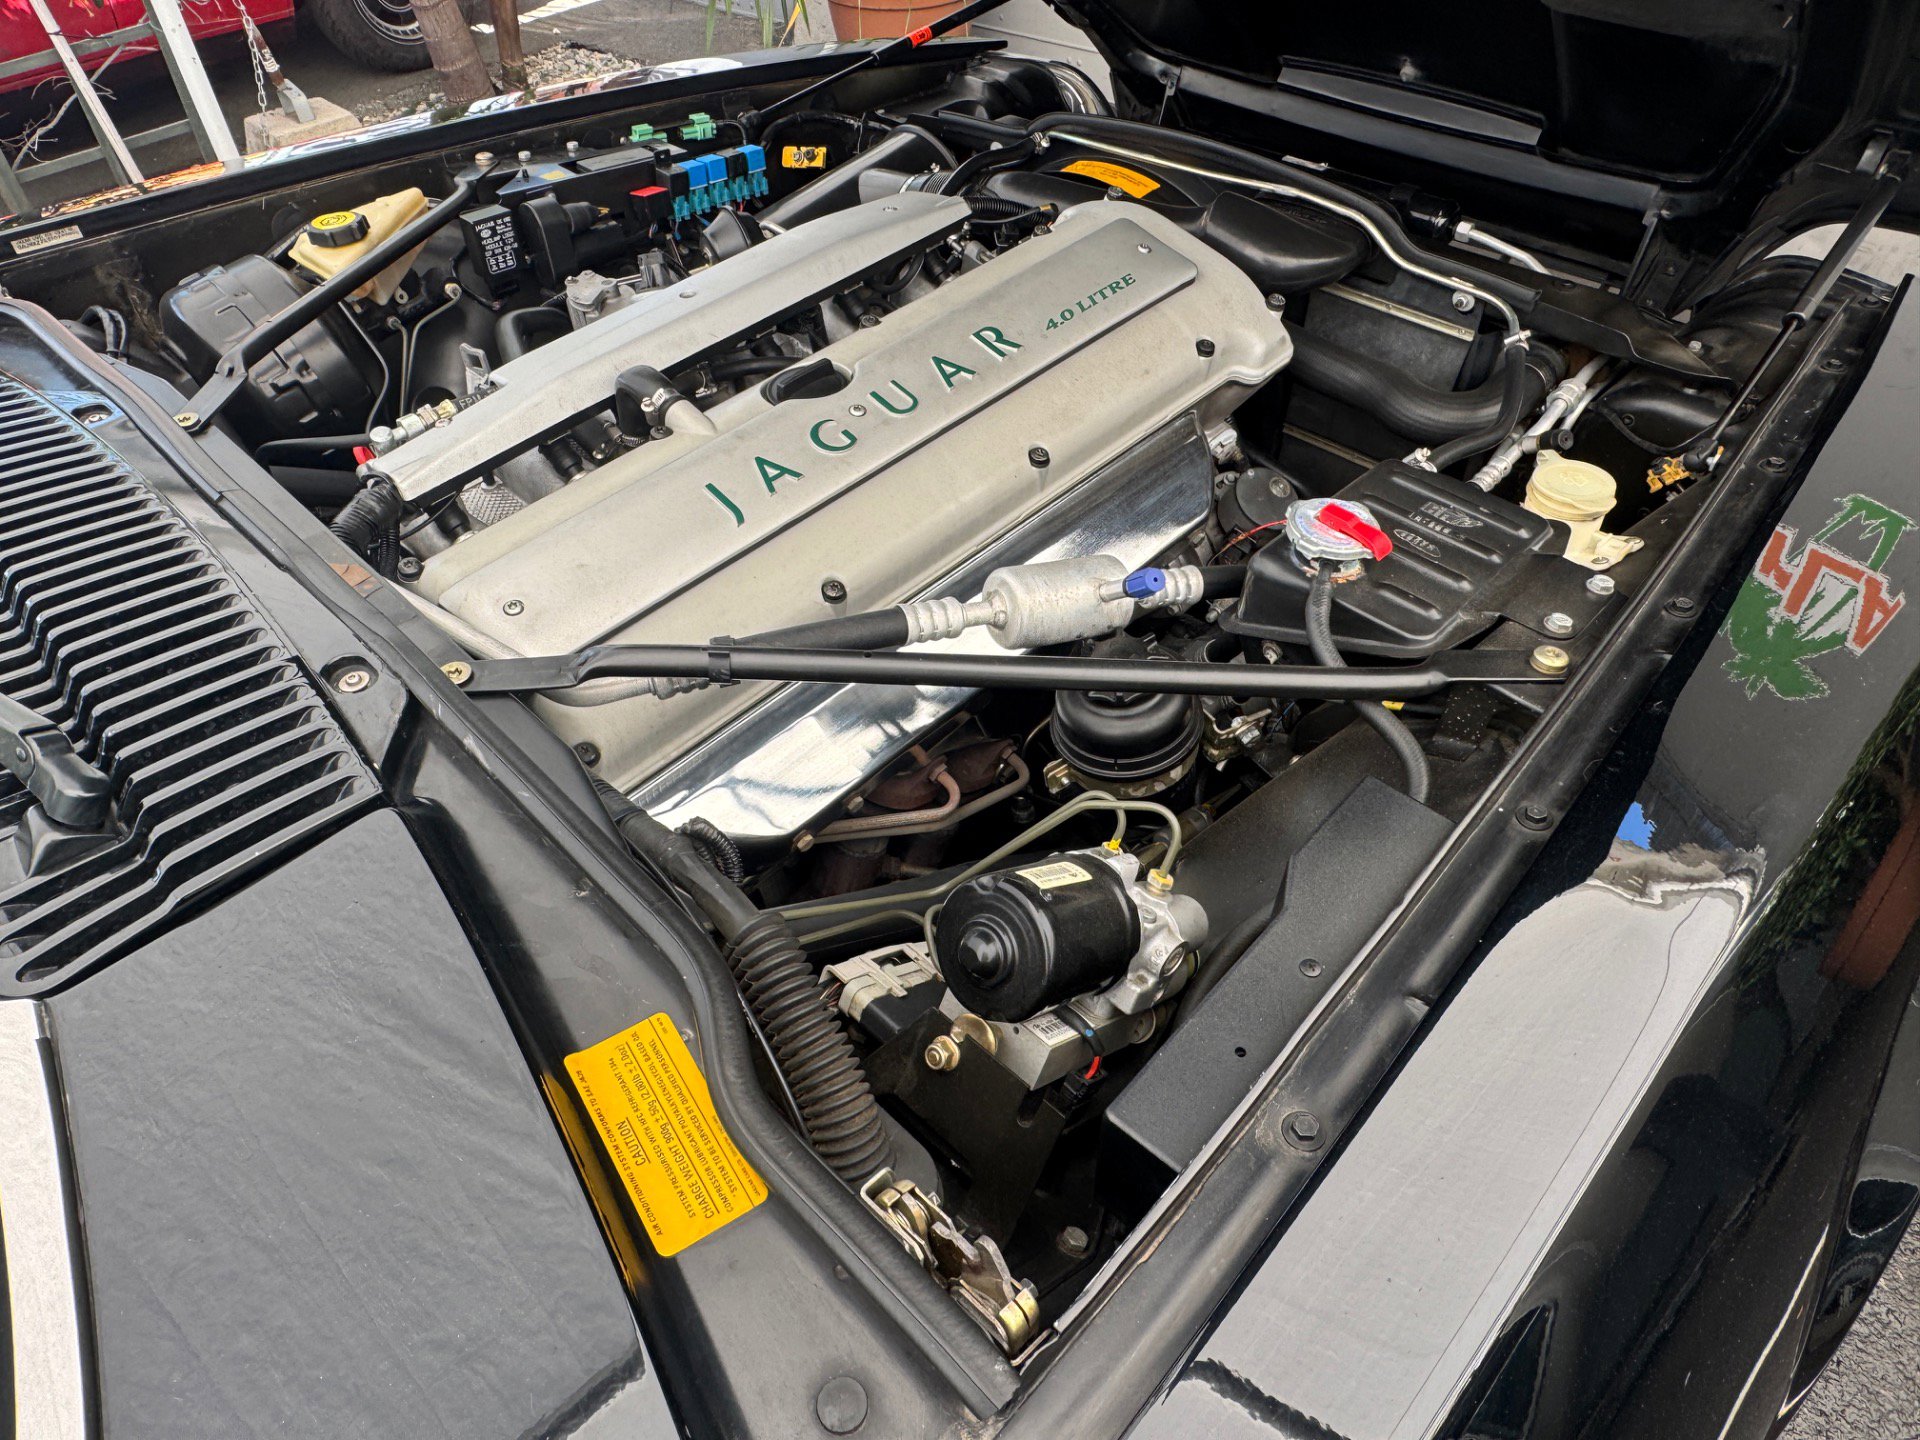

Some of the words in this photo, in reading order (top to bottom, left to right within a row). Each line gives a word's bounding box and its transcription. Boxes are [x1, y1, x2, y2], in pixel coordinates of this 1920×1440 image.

[1045, 308, 1075, 332] 4.0
[1076, 273, 1137, 315] LITRE
[704, 325, 1024, 527] JAGUAR
[635, 1040, 651, 1062] BASED
[589, 1096, 598, 1106] TO
[645, 1099, 661, 1116] 50g
[683, 1104, 694, 1115] BY
[593, 1106, 616, 1143] CONFORMS
[642, 1125, 657, 1144] WITH
[657, 1121, 676, 1144] 900g
[688, 1114, 710, 1145] SERVICED
[612, 1143, 630, 1171] SYSTEM
[615, 1119, 647, 1166] CAUTION
[683, 1128, 708, 1166] LUBRICANT
[705, 1145, 716, 1155] BE
[651, 1144, 681, 1190] PRESSURISED
[668, 1143, 694, 1180] WEIGHT
[710, 1154, 721, 1165] TO
[625, 1170, 657, 1222] CONDITIONING
[676, 1189, 696, 1218] SYSTEM
[688, 1179, 715, 1219] CHARGE
[703, 1165, 734, 1213] COMPRESSOR
[652, 1223, 663, 1236] AIR
